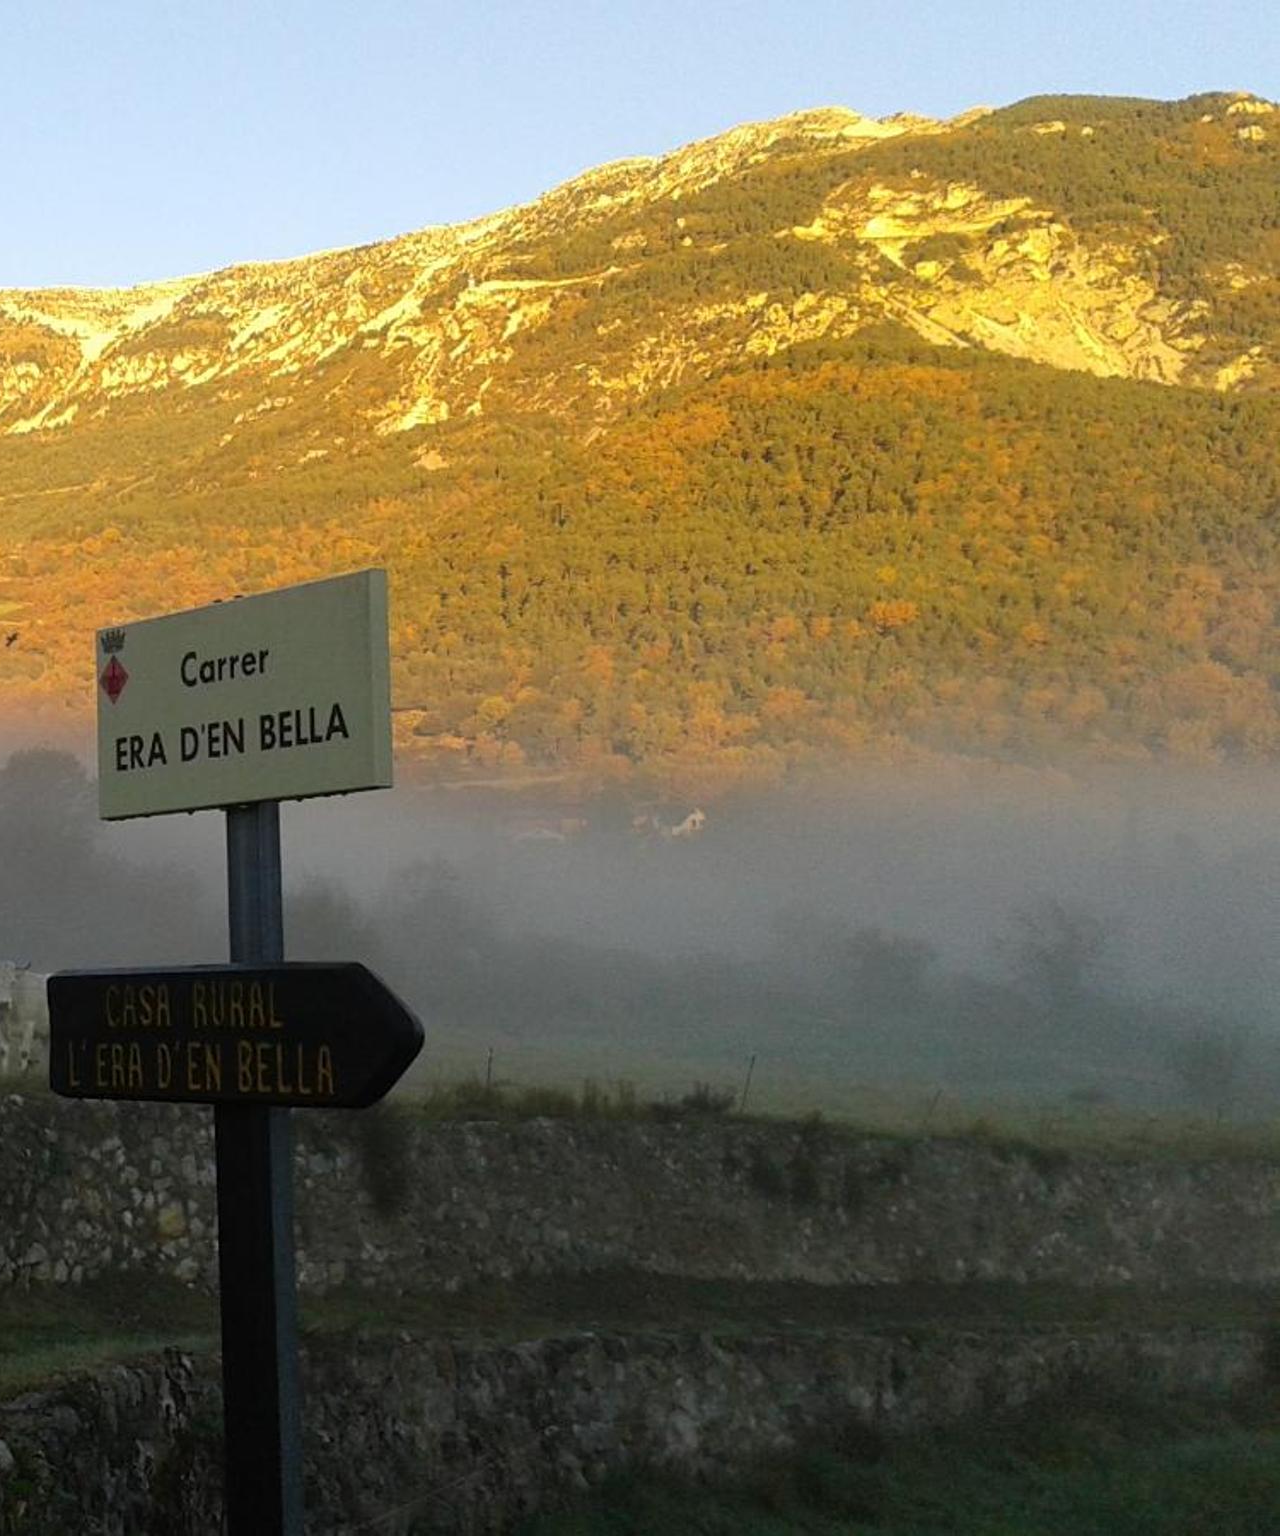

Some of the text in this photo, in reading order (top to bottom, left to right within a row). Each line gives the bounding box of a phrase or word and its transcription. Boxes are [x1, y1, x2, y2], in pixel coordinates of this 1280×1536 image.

[180, 649, 269, 687] Carrer
[116, 703, 350, 771] ERA D'EN BELLA
[105, 981, 284, 1028] CASA RURAL
[157, 1041, 222, 1091] D'EN
[238, 1040, 335, 1095] BELLA
